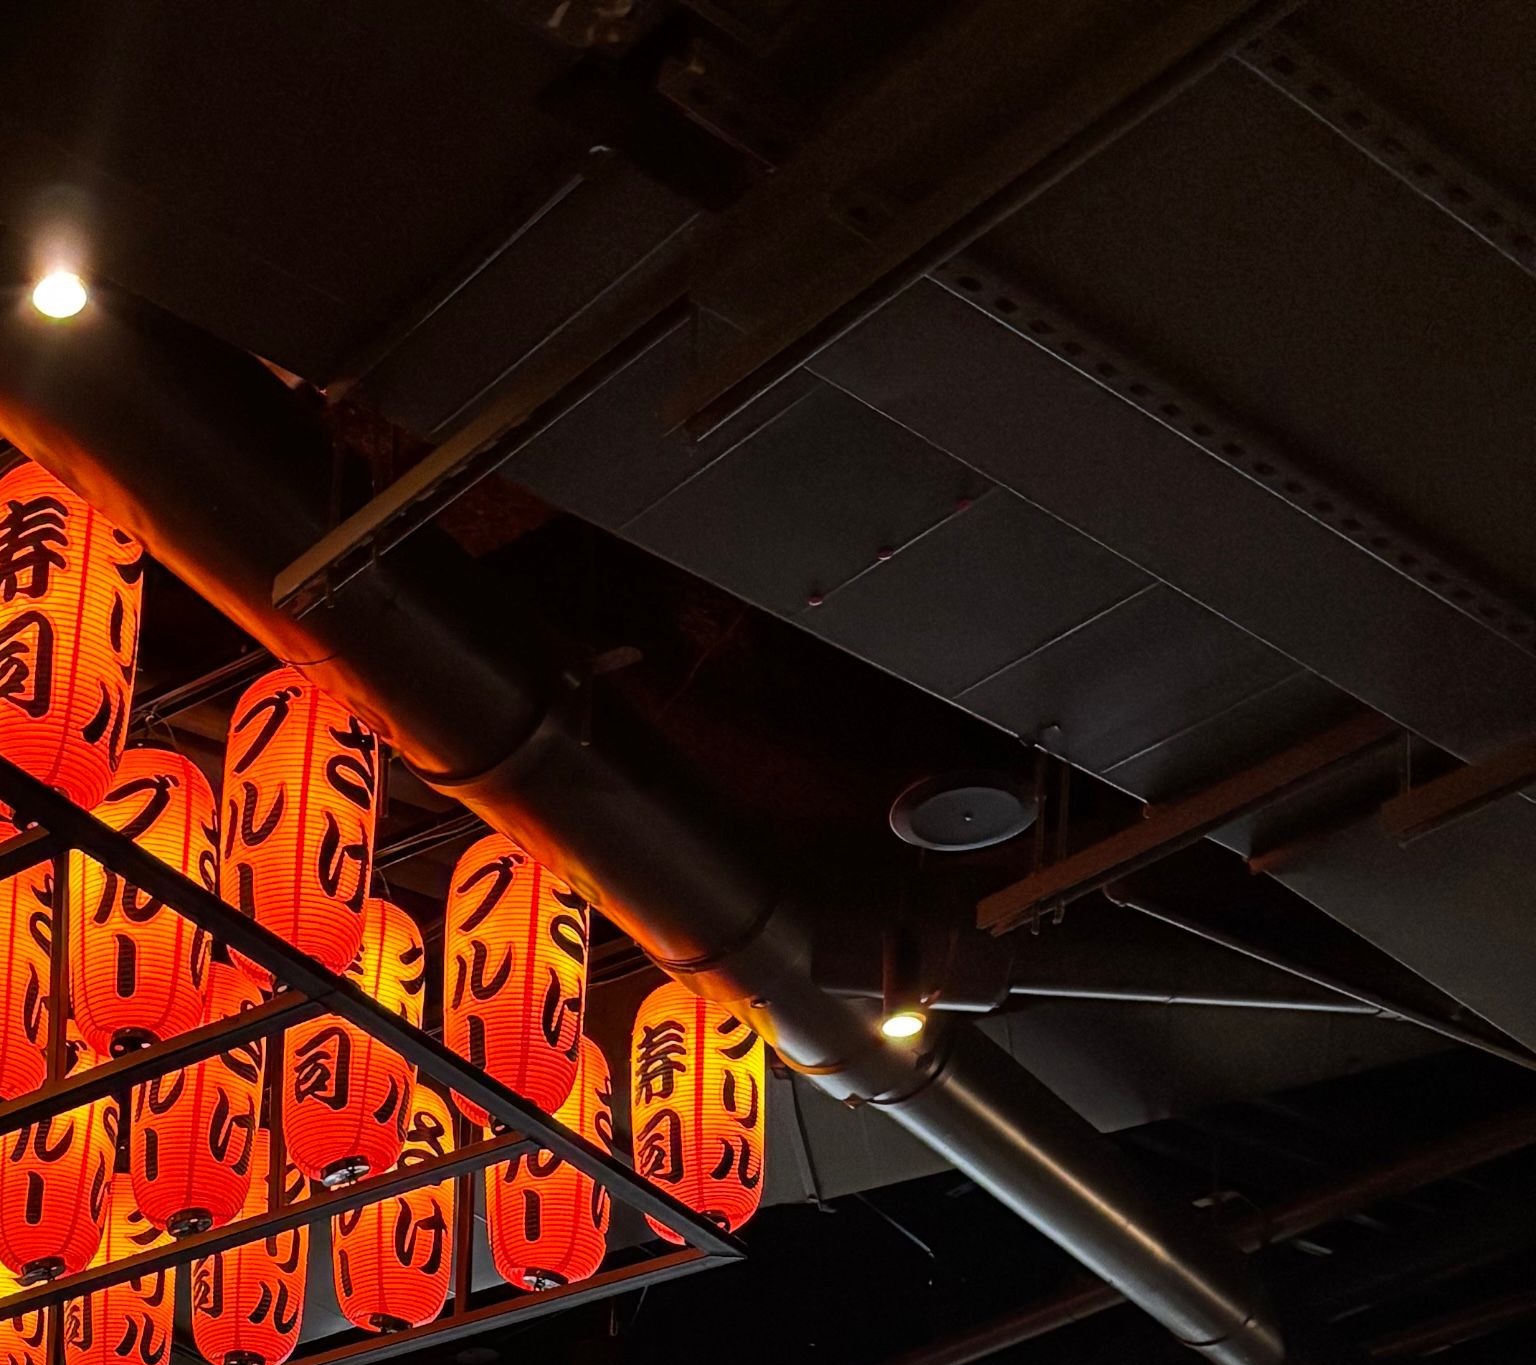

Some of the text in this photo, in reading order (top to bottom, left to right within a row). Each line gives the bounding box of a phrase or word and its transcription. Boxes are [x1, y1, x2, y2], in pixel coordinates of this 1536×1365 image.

[225, 686, 302, 922] ブルー
[452, 854, 525, 1072] ブルー
[294, 1026, 350, 1110] 司
[635, 1020, 686, 1182] 寿司
[11, 1121, 74, 1225] ルー
[134, 1069, 185, 1181] ルー
[504, 1149, 564, 1242] ルー
[115, 1272, 165, 1365] リル
[247, 1229, 299, 1334] リル
